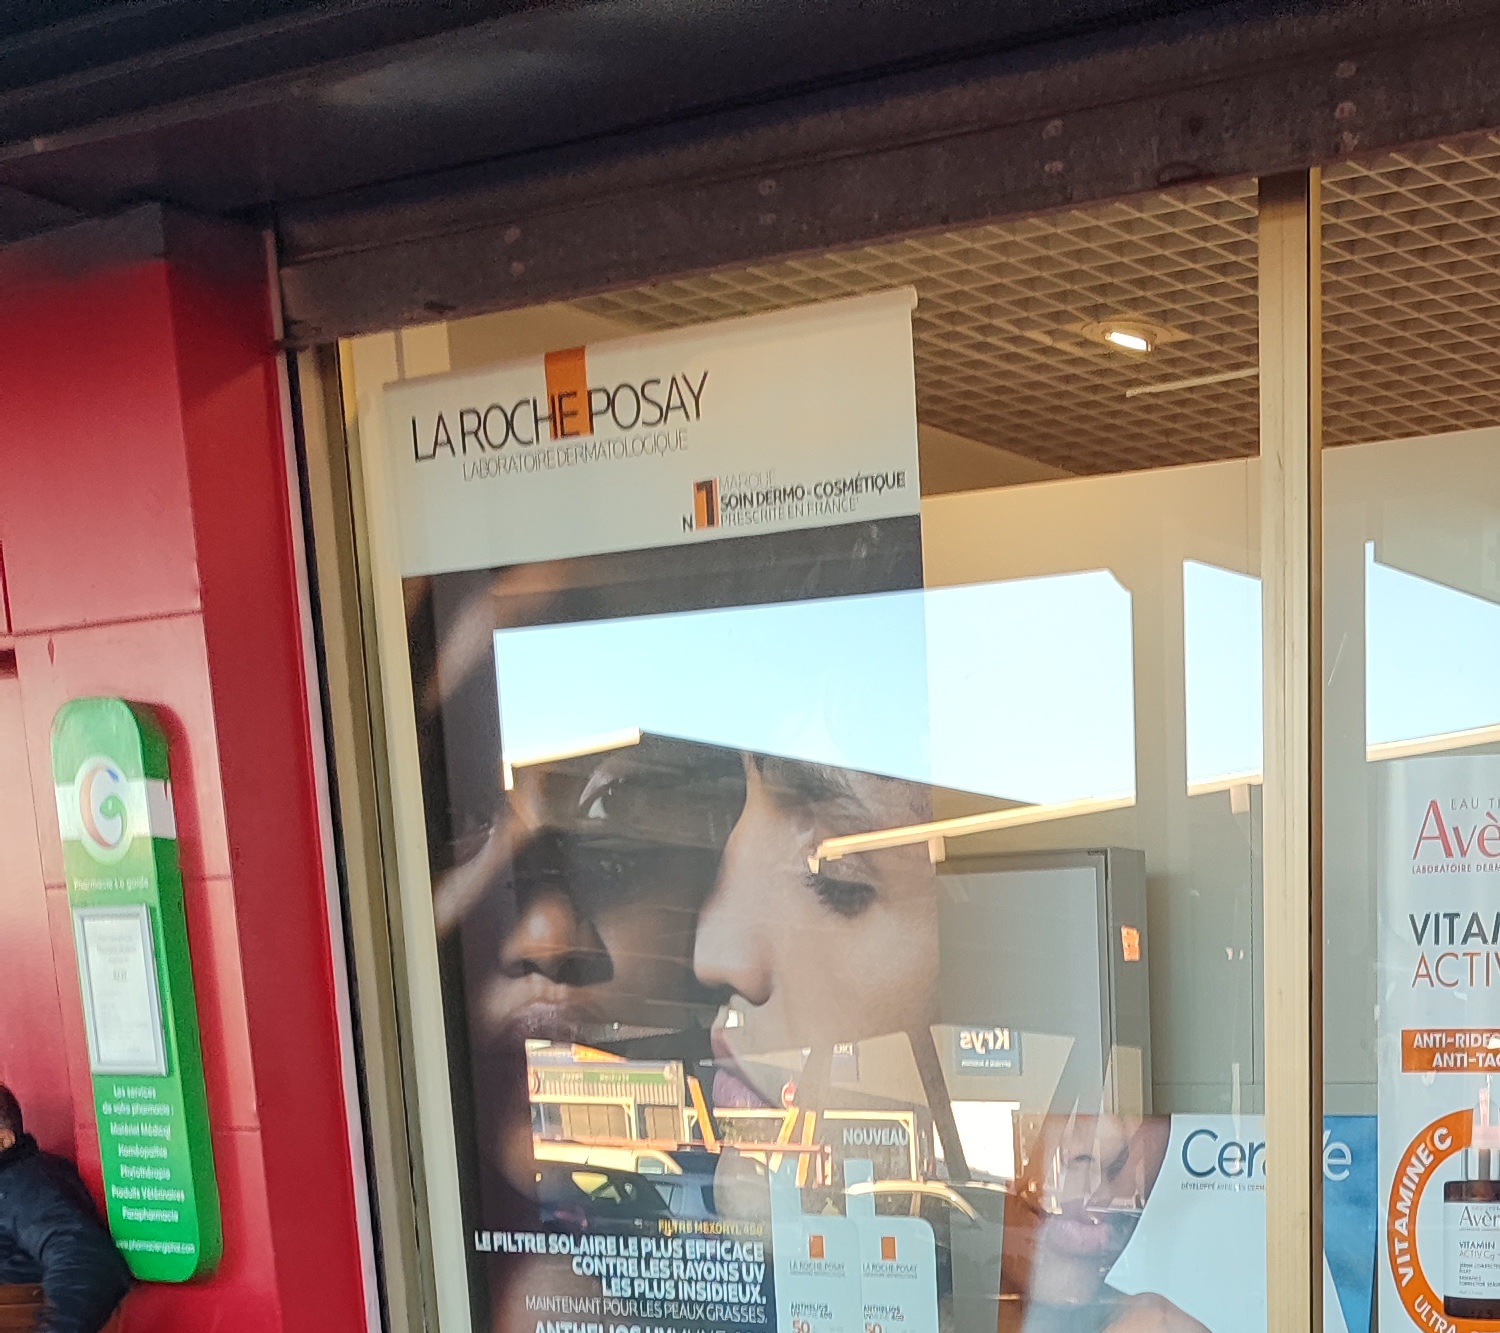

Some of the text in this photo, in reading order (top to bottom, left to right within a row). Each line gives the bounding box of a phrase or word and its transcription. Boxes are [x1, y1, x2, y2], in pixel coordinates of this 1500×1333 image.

[412, 370, 708, 463] LA ROCHE POSAY
[462, 428, 688, 481] LABORATOIRE DERMATOLOGIQUE
[721, 493, 755, 512] SOIN
[787, 502, 804, 518] EN
[1450, 797, 1480, 811] EAU
[1411, 864, 1472, 875] LABORATOIRE
[843, 1127, 909, 1146] NOUVEAU
[1394, 1127, 1453, 1288] VITAMINE C
[475, 1230, 765, 1262] LE FILTRE SOLAIRE LE PLUS EFFICACE
[1459, 1240, 1496, 1250] VITAMIN
[572, 1255, 766, 1283] CONTRE LES RAYONS UV
[602, 1277, 767, 1304] LES PLUS INSIDIEUX.
[525, 1294, 601, 1316] MAINTENANT
[603, 1298, 638, 1318] POUR
[639, 1301, 663, 1319] LES
[664, 1302, 704, 1322] PEAUX
[706, 1304, 768, 1325] GRASSES.
